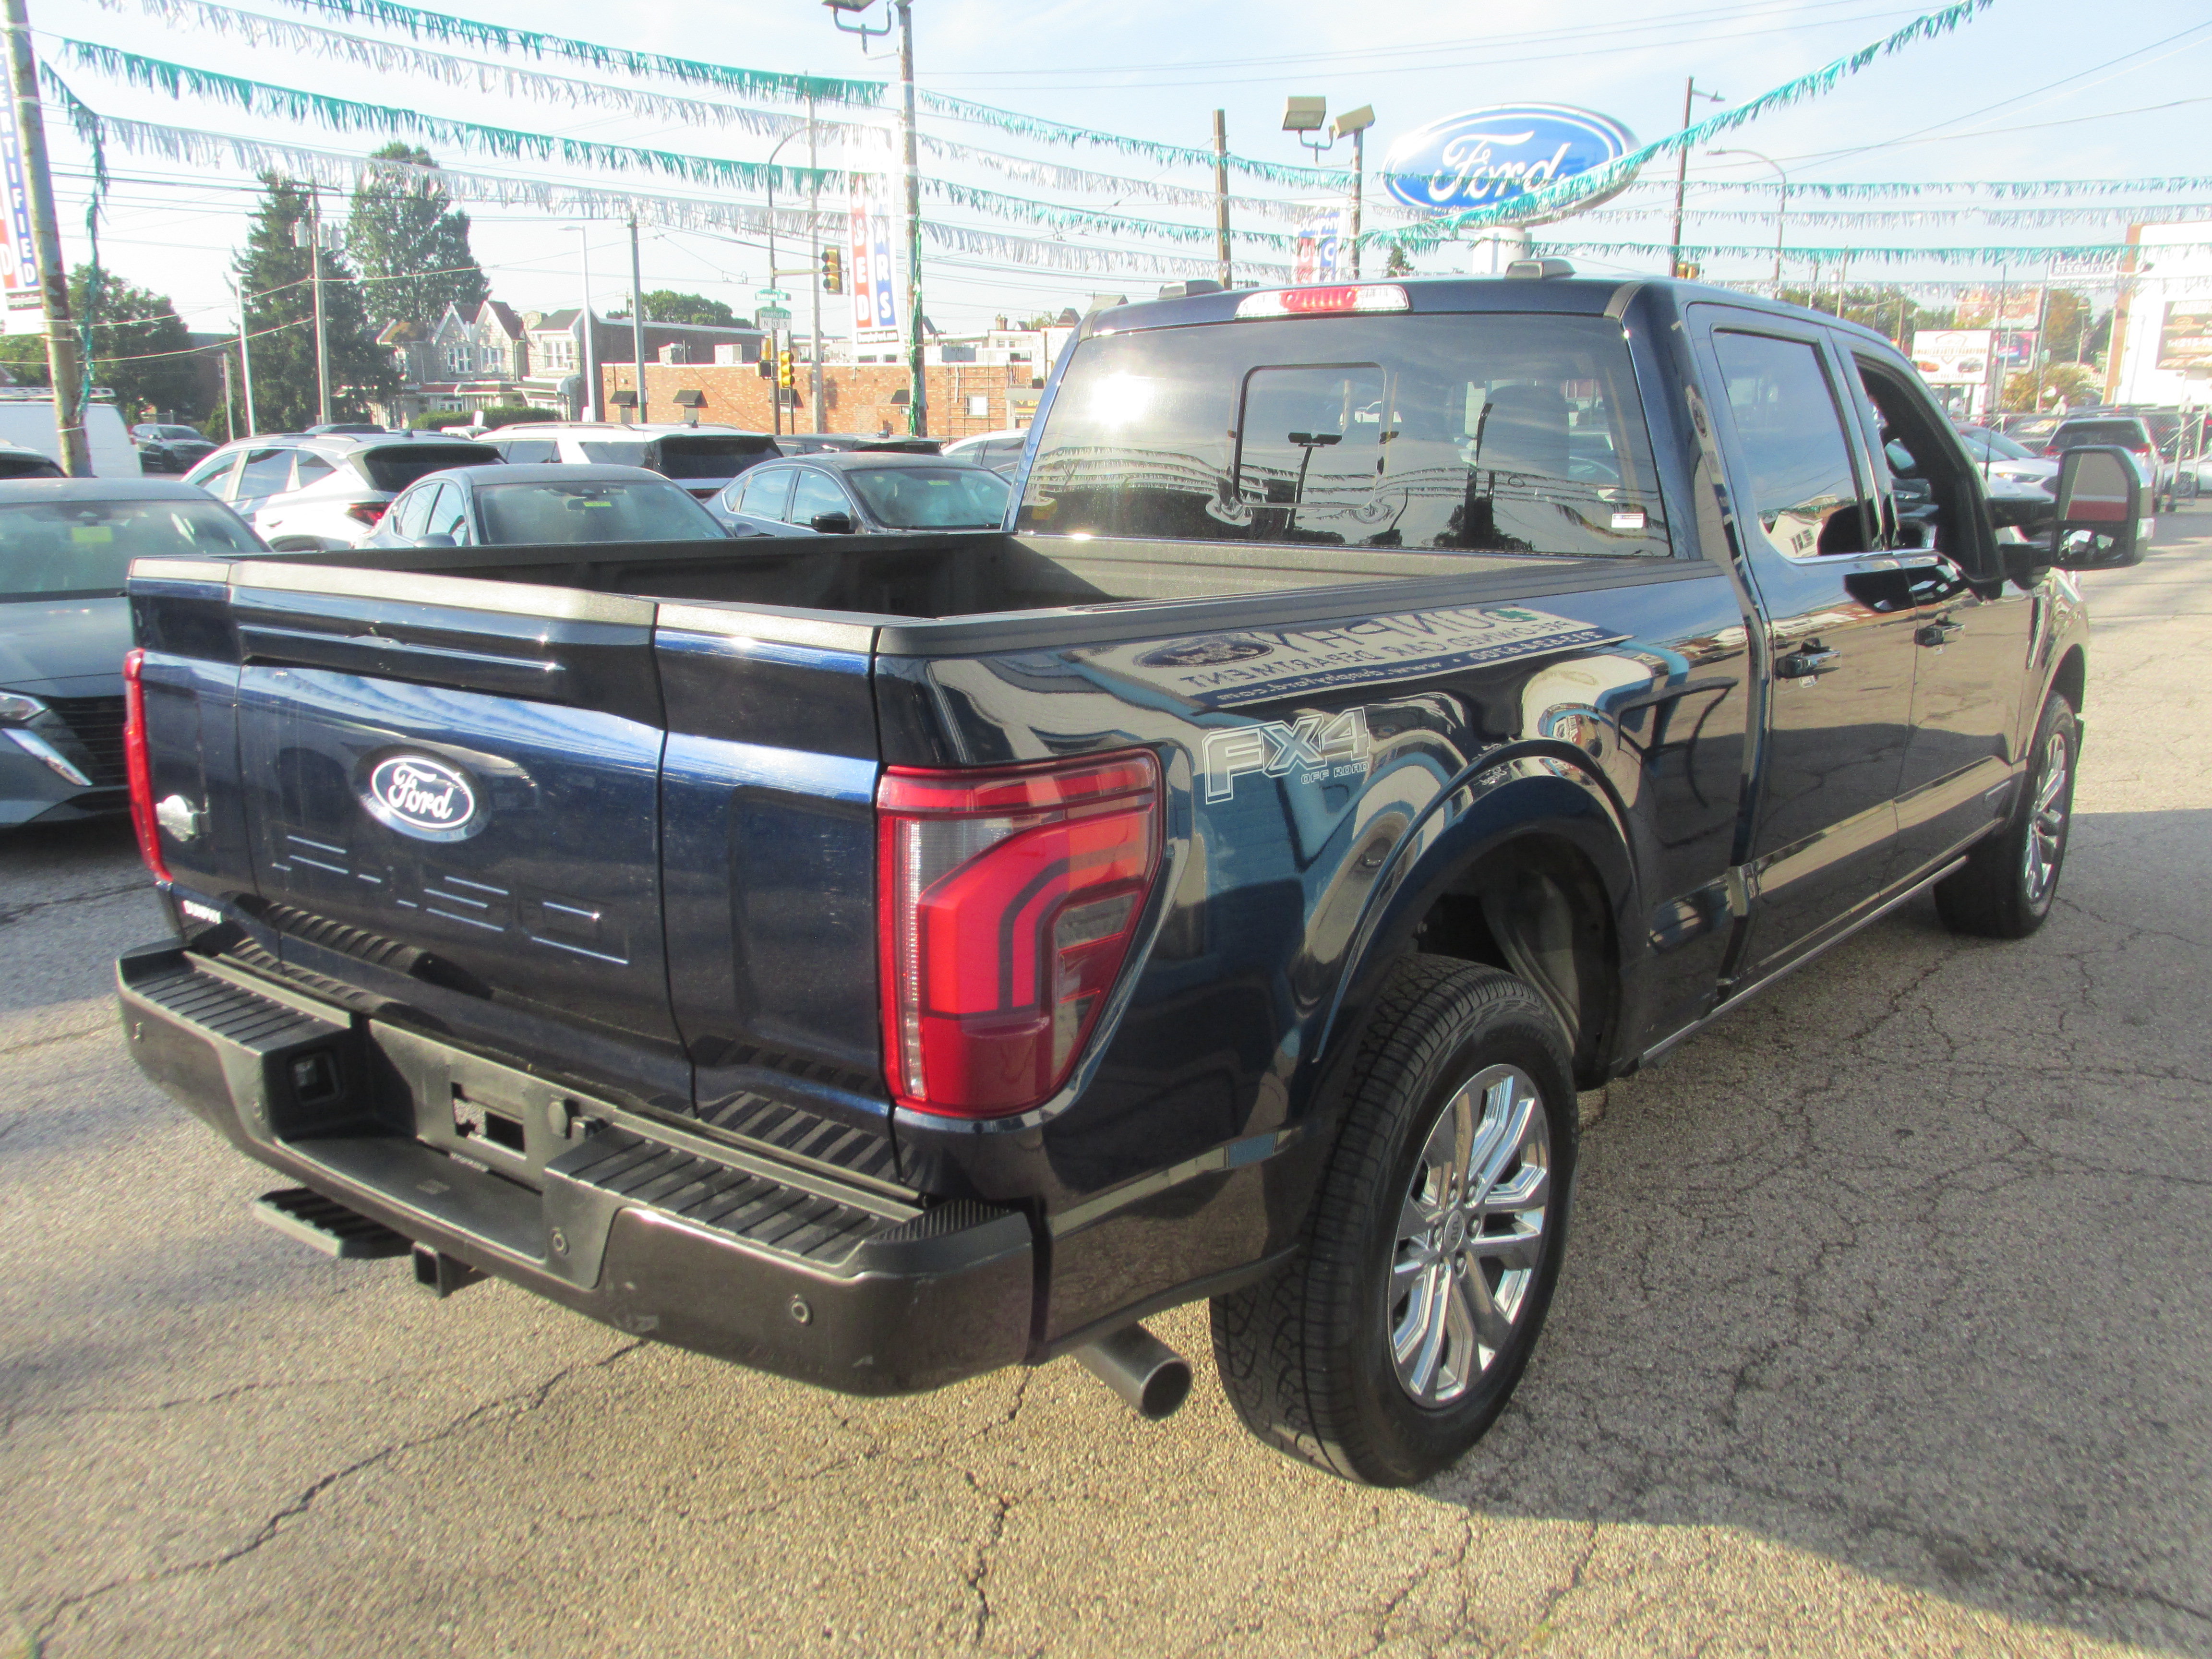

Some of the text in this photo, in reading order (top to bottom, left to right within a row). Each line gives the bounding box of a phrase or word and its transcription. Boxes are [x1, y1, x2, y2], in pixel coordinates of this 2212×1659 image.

[0, 58, 36, 283] ERTIFIED
[1428, 131, 1571, 202] Ford
[1202, 706, 1370, 805] FX4
[1301, 761, 1369, 785] OFF ROAD
[387, 765, 454, 819] Ford
